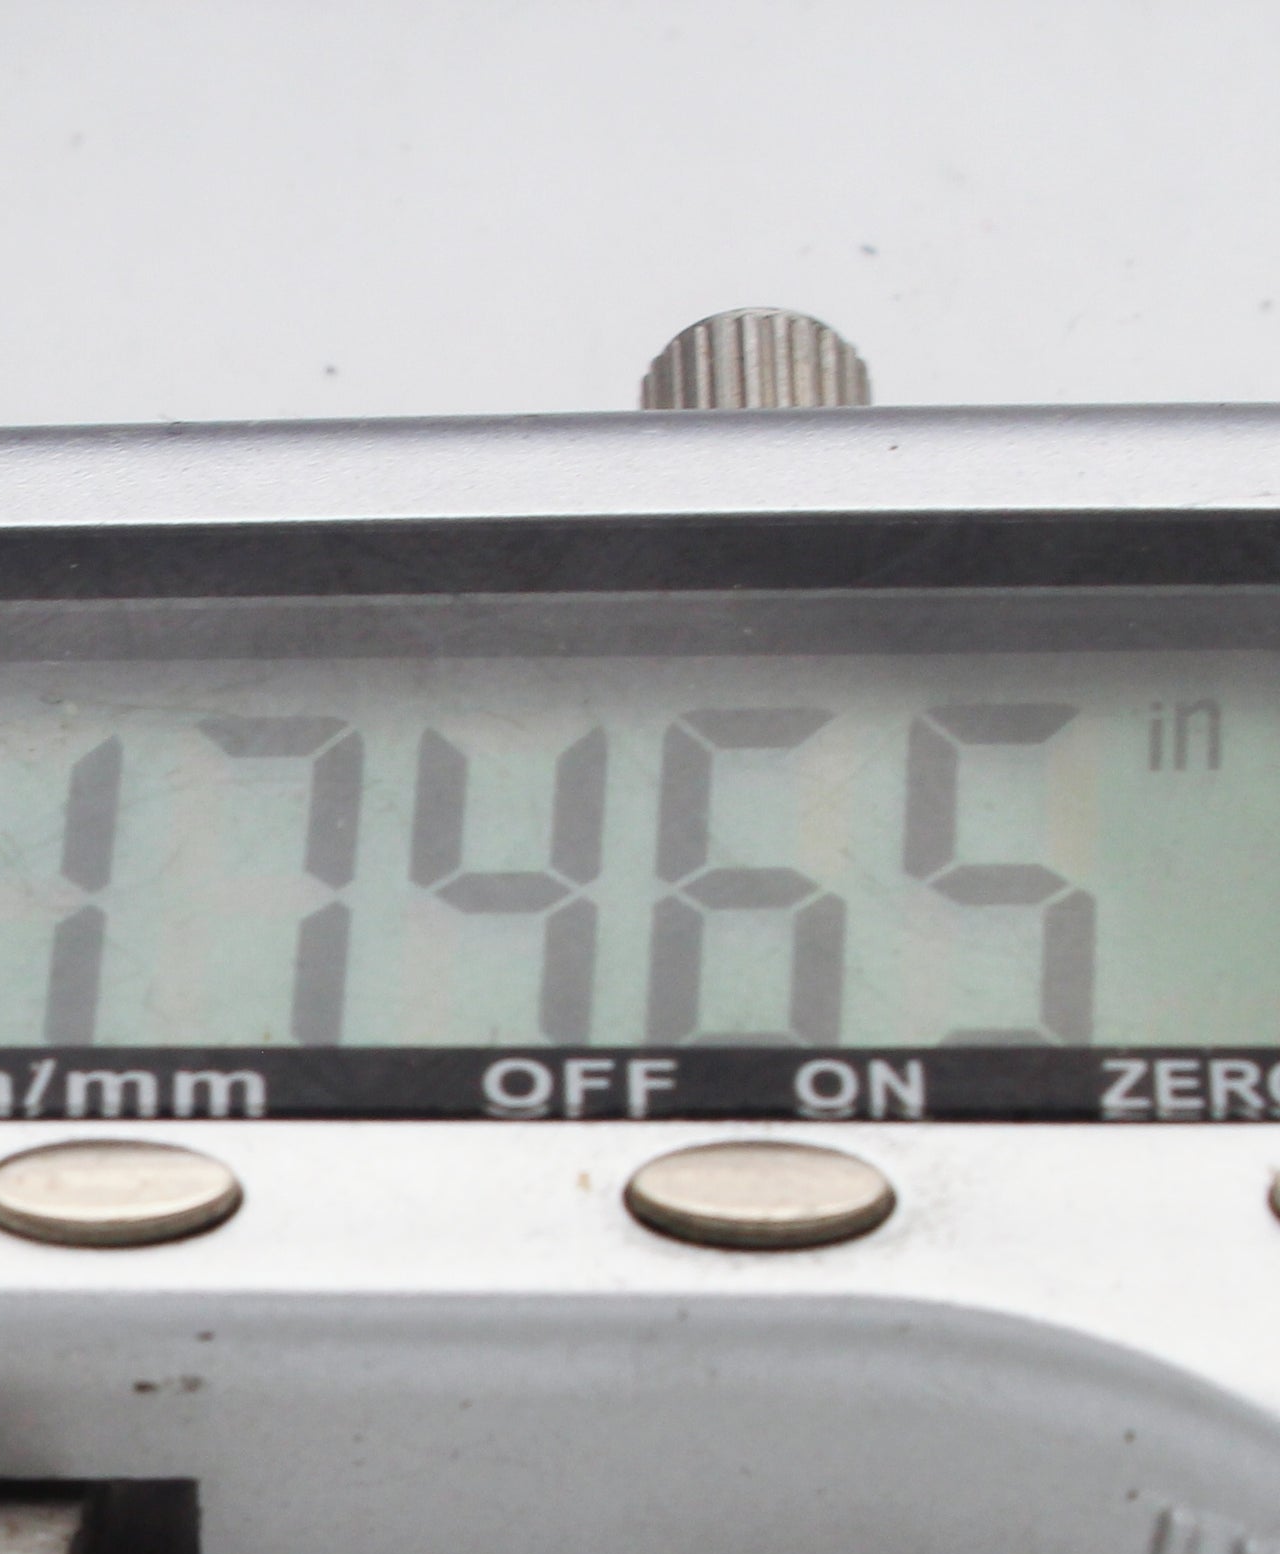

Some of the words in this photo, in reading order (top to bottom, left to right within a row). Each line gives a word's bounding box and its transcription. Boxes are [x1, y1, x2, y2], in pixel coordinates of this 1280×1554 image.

[1147, 697, 1222, 772] in
[480, 1056, 680, 1118] OFF
[795, 1056, 926, 1118] ON
[1101, 1057, 1280, 1118] ZER
